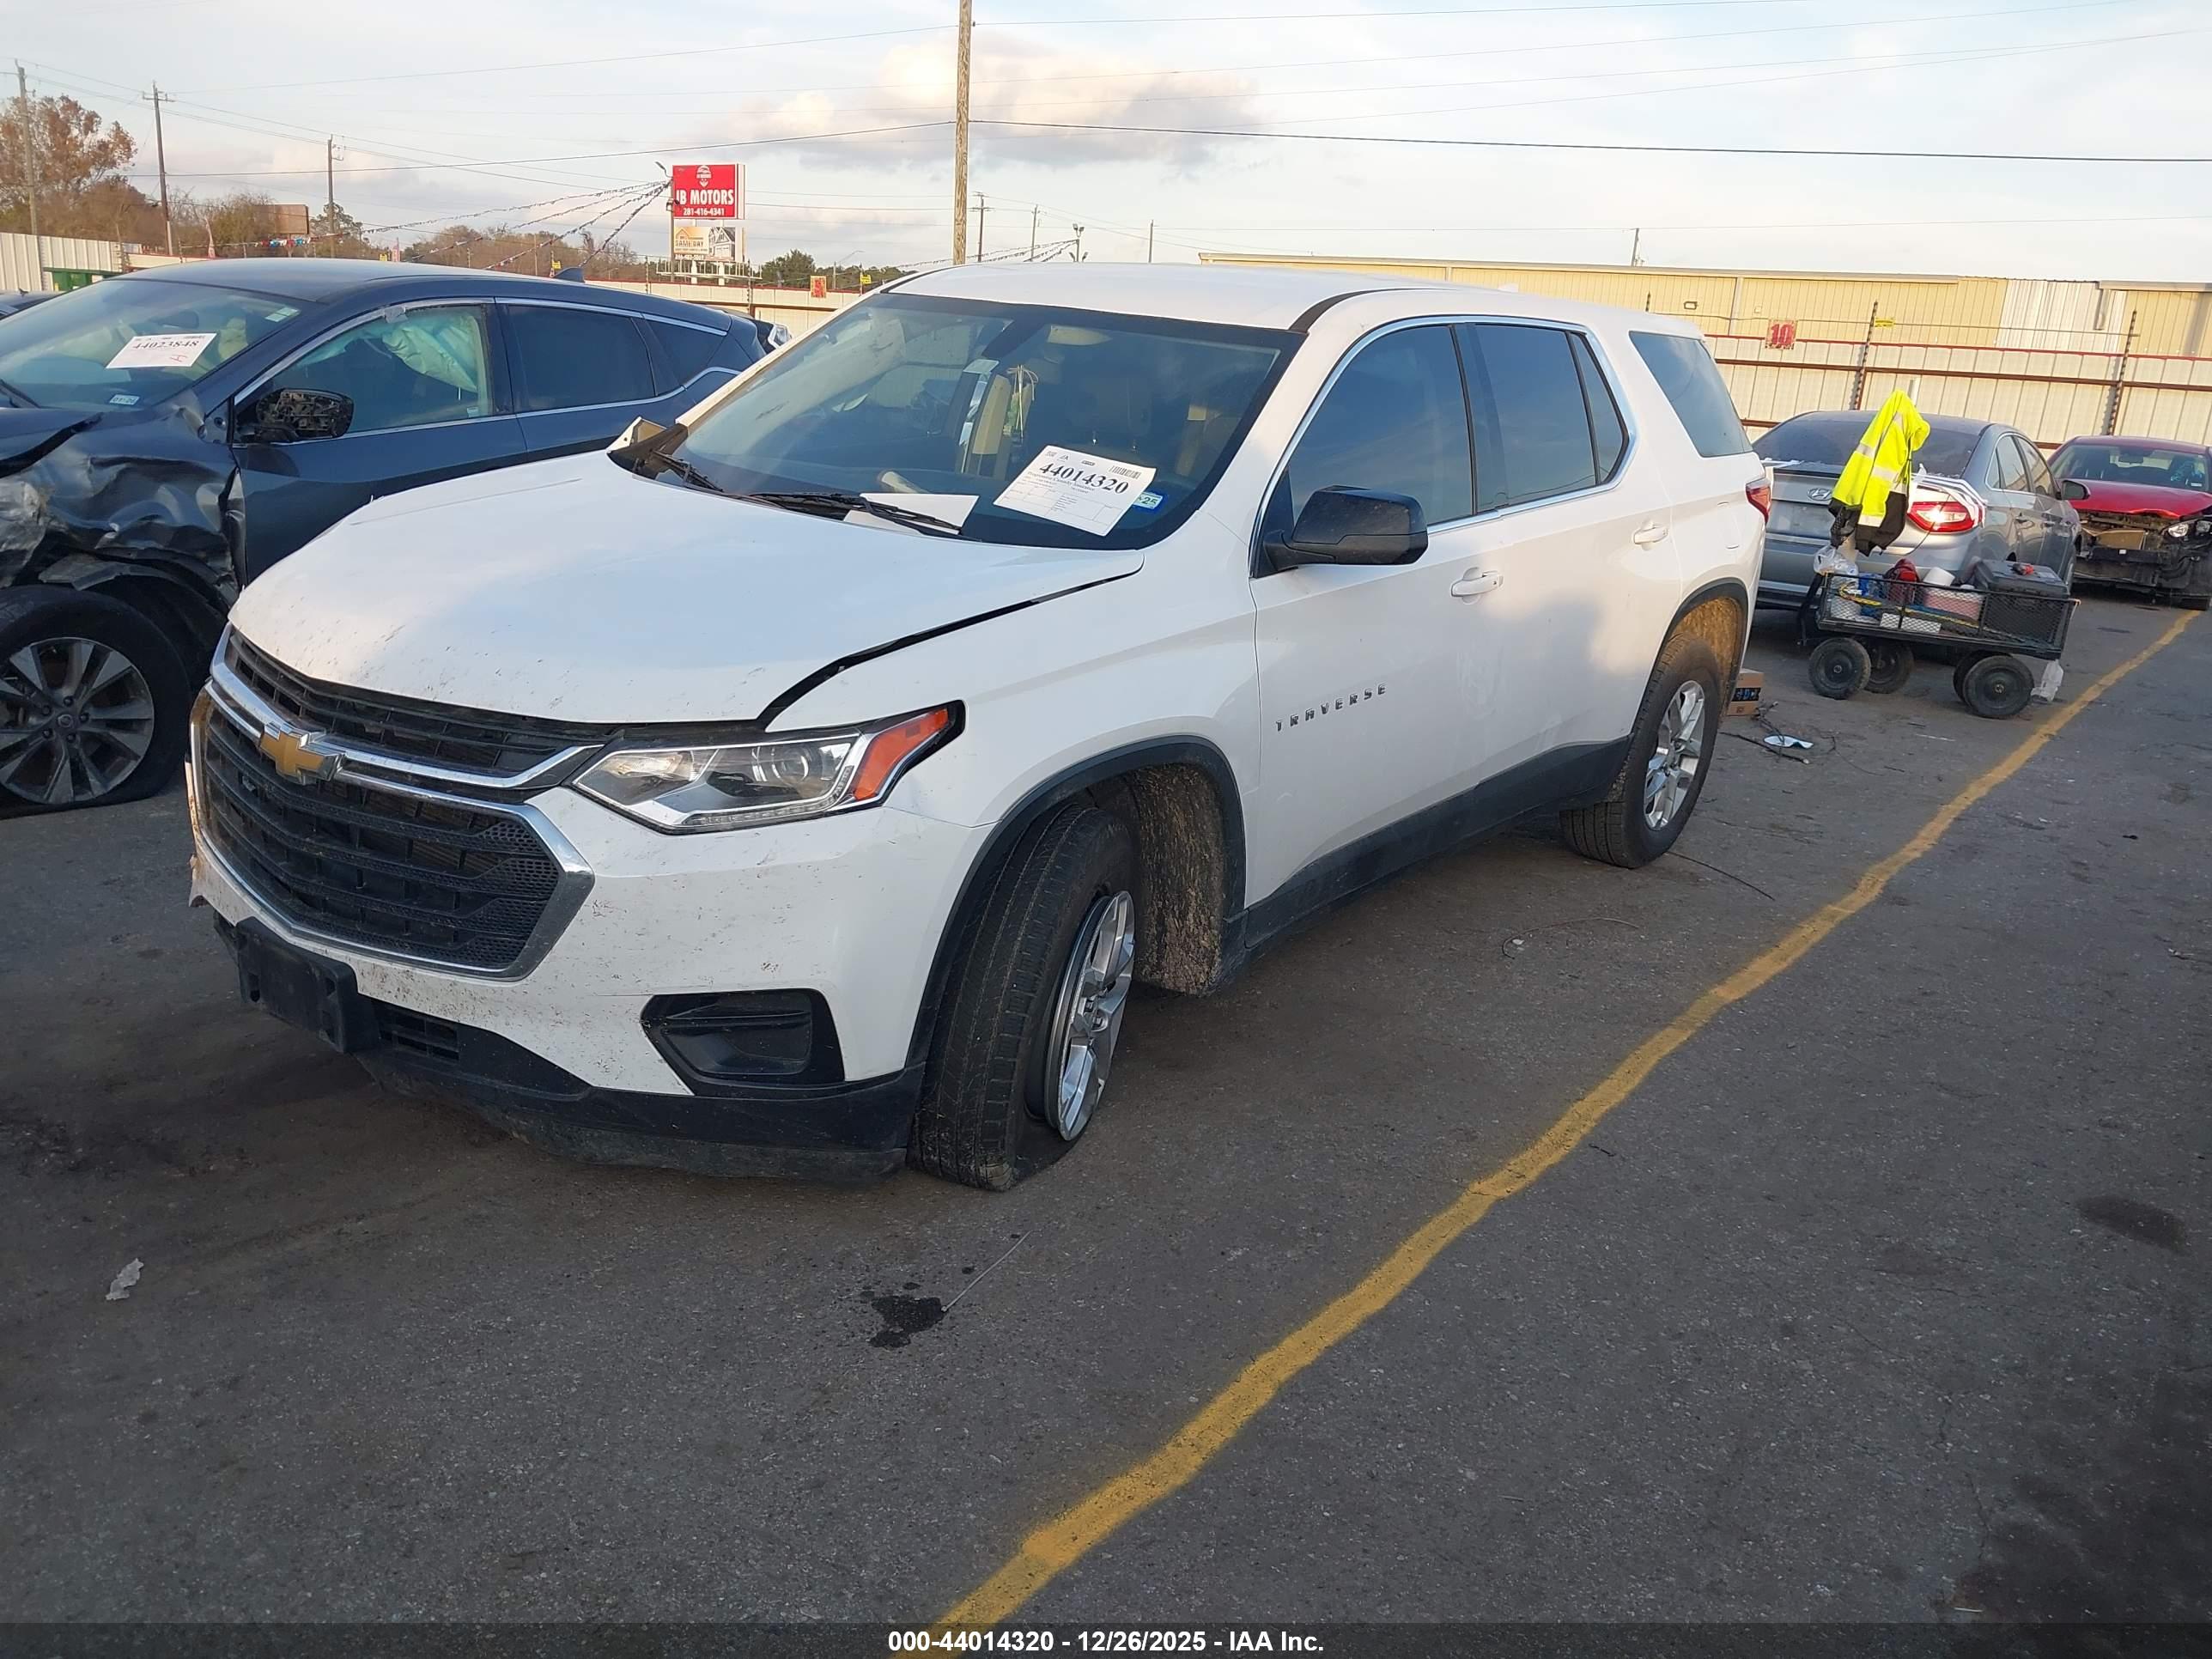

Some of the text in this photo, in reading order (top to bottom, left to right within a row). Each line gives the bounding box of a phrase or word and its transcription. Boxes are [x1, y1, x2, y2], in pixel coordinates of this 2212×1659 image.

[690, 189, 734, 205] MOTORS
[683, 207, 725, 216] 281-416-4341
[1771, 323, 1794, 348] 10
[132, 340, 199, 349] 44023848
[1039, 462, 1129, 495] 44014320
[1141, 496, 1158, 505] 25
[1275, 684, 1386, 732] TRAVERSE
